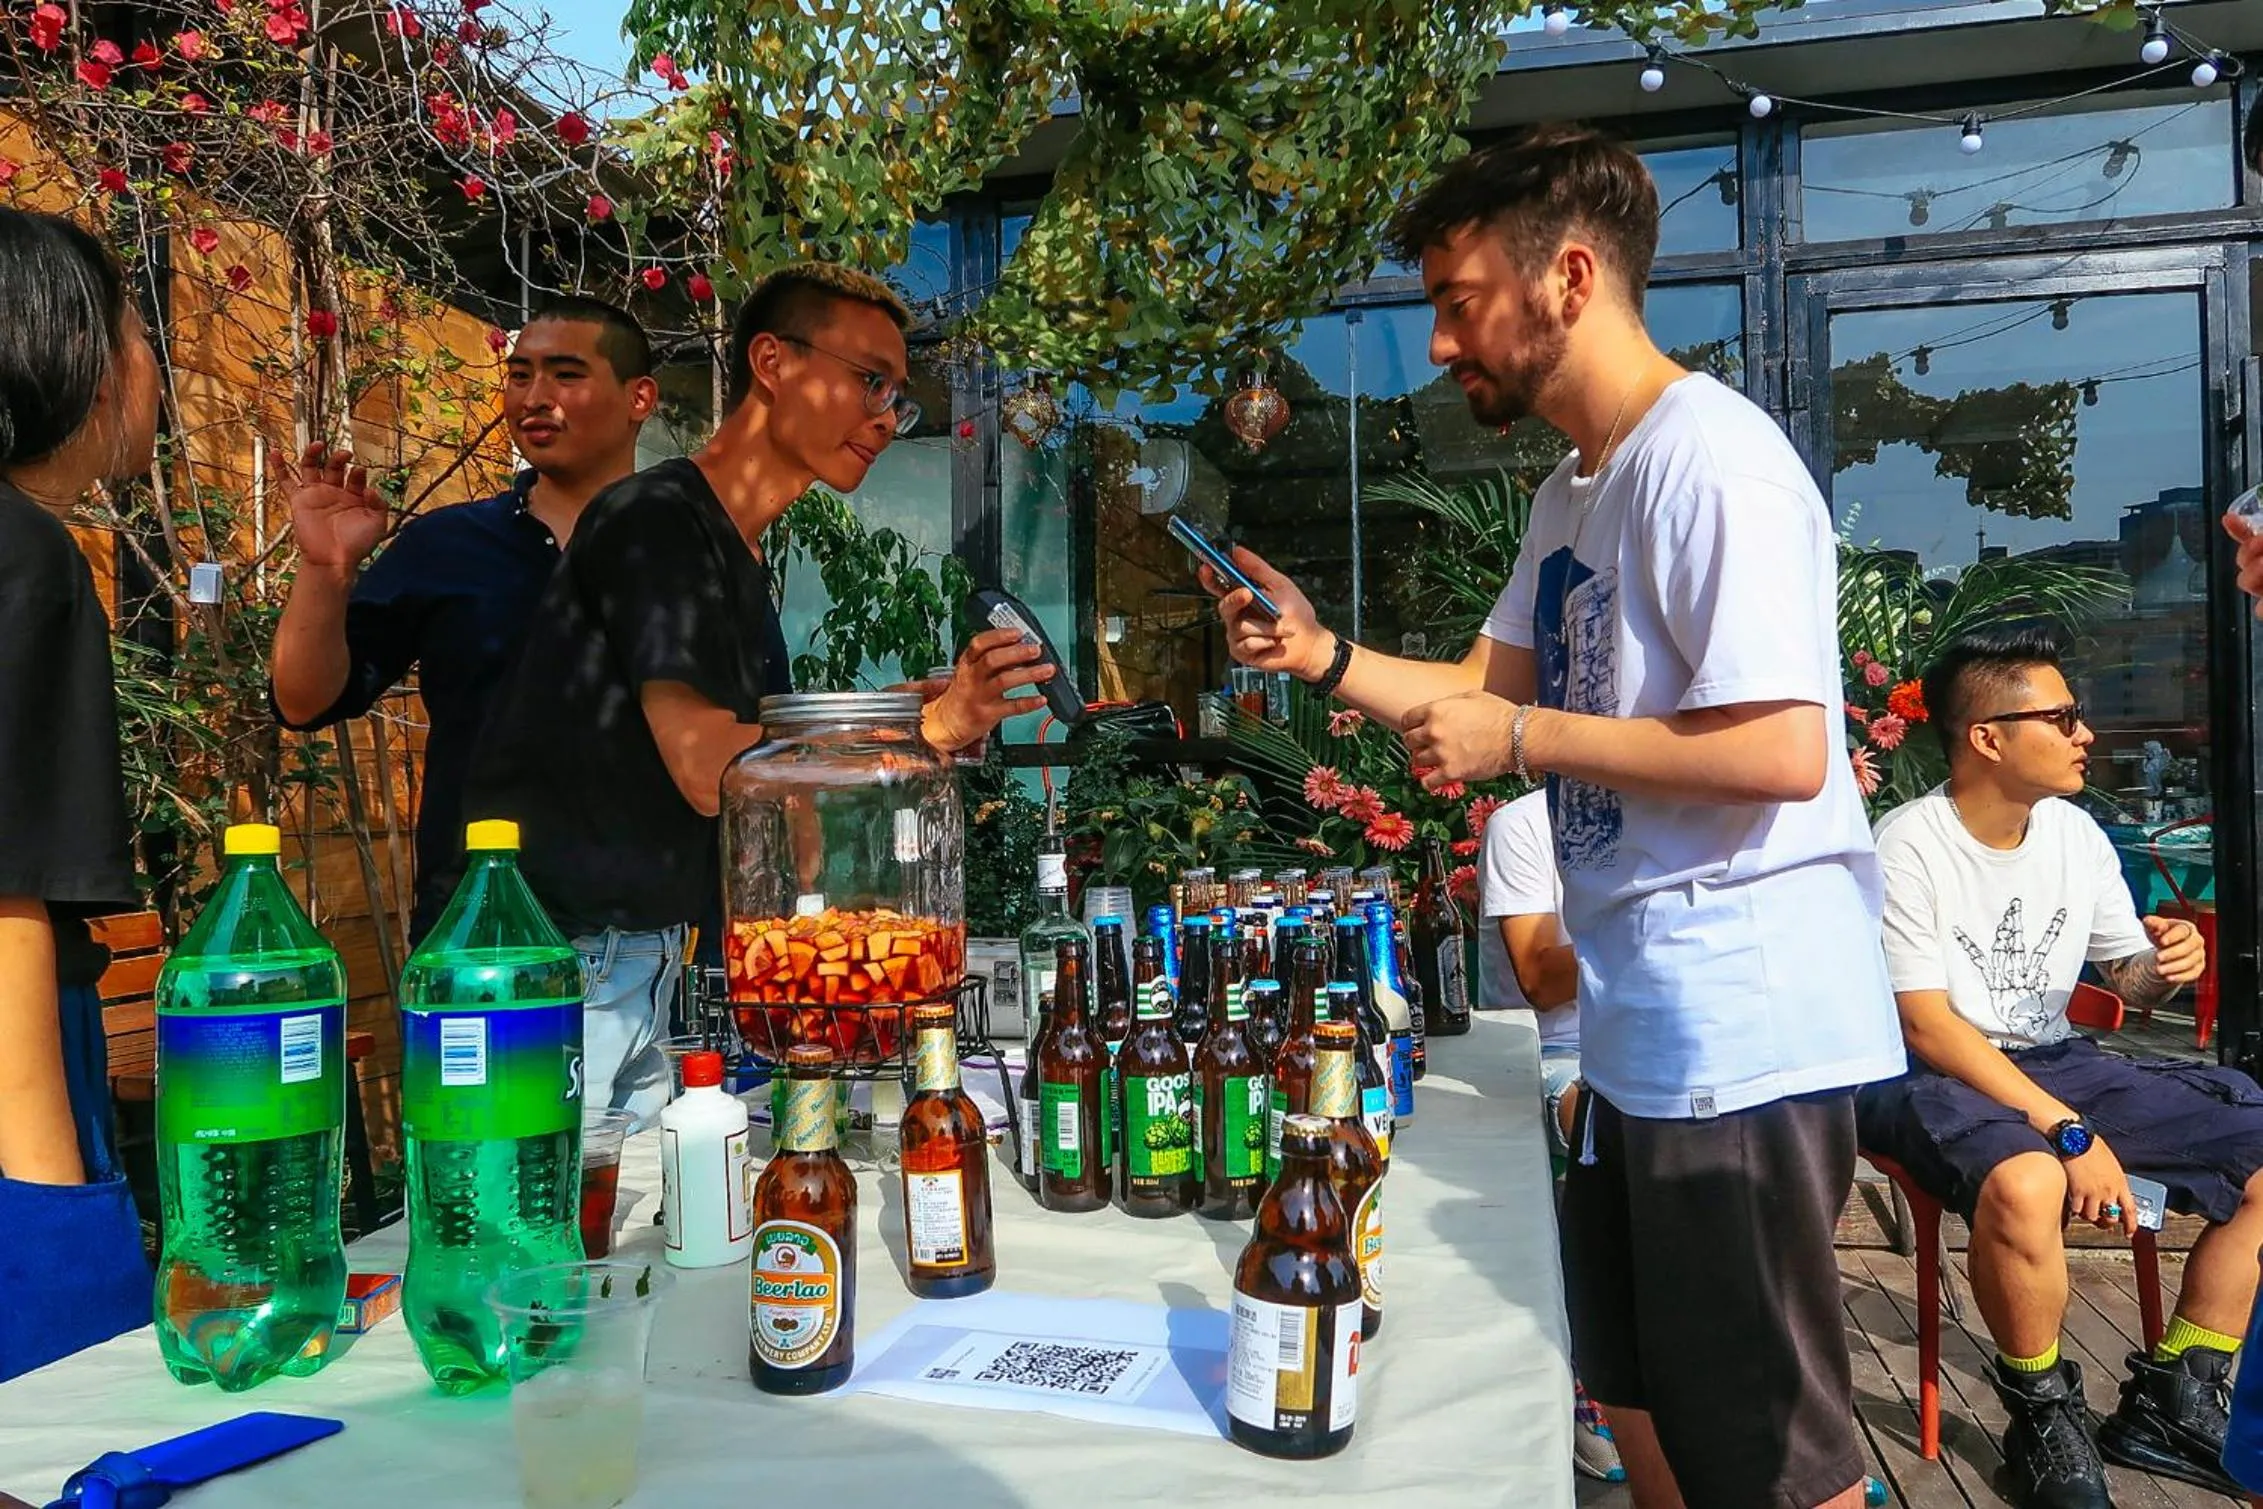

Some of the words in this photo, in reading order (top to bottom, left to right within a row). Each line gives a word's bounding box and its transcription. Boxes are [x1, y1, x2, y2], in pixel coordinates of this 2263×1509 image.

[1146, 1072, 1190, 1092] GOOS
[1147, 1090, 1178, 1116] IPA
[1248, 1091, 1264, 1115] IP
[753, 1275, 828, 1299] Beerlao
[785, 1334, 826, 1361] COMPANY
